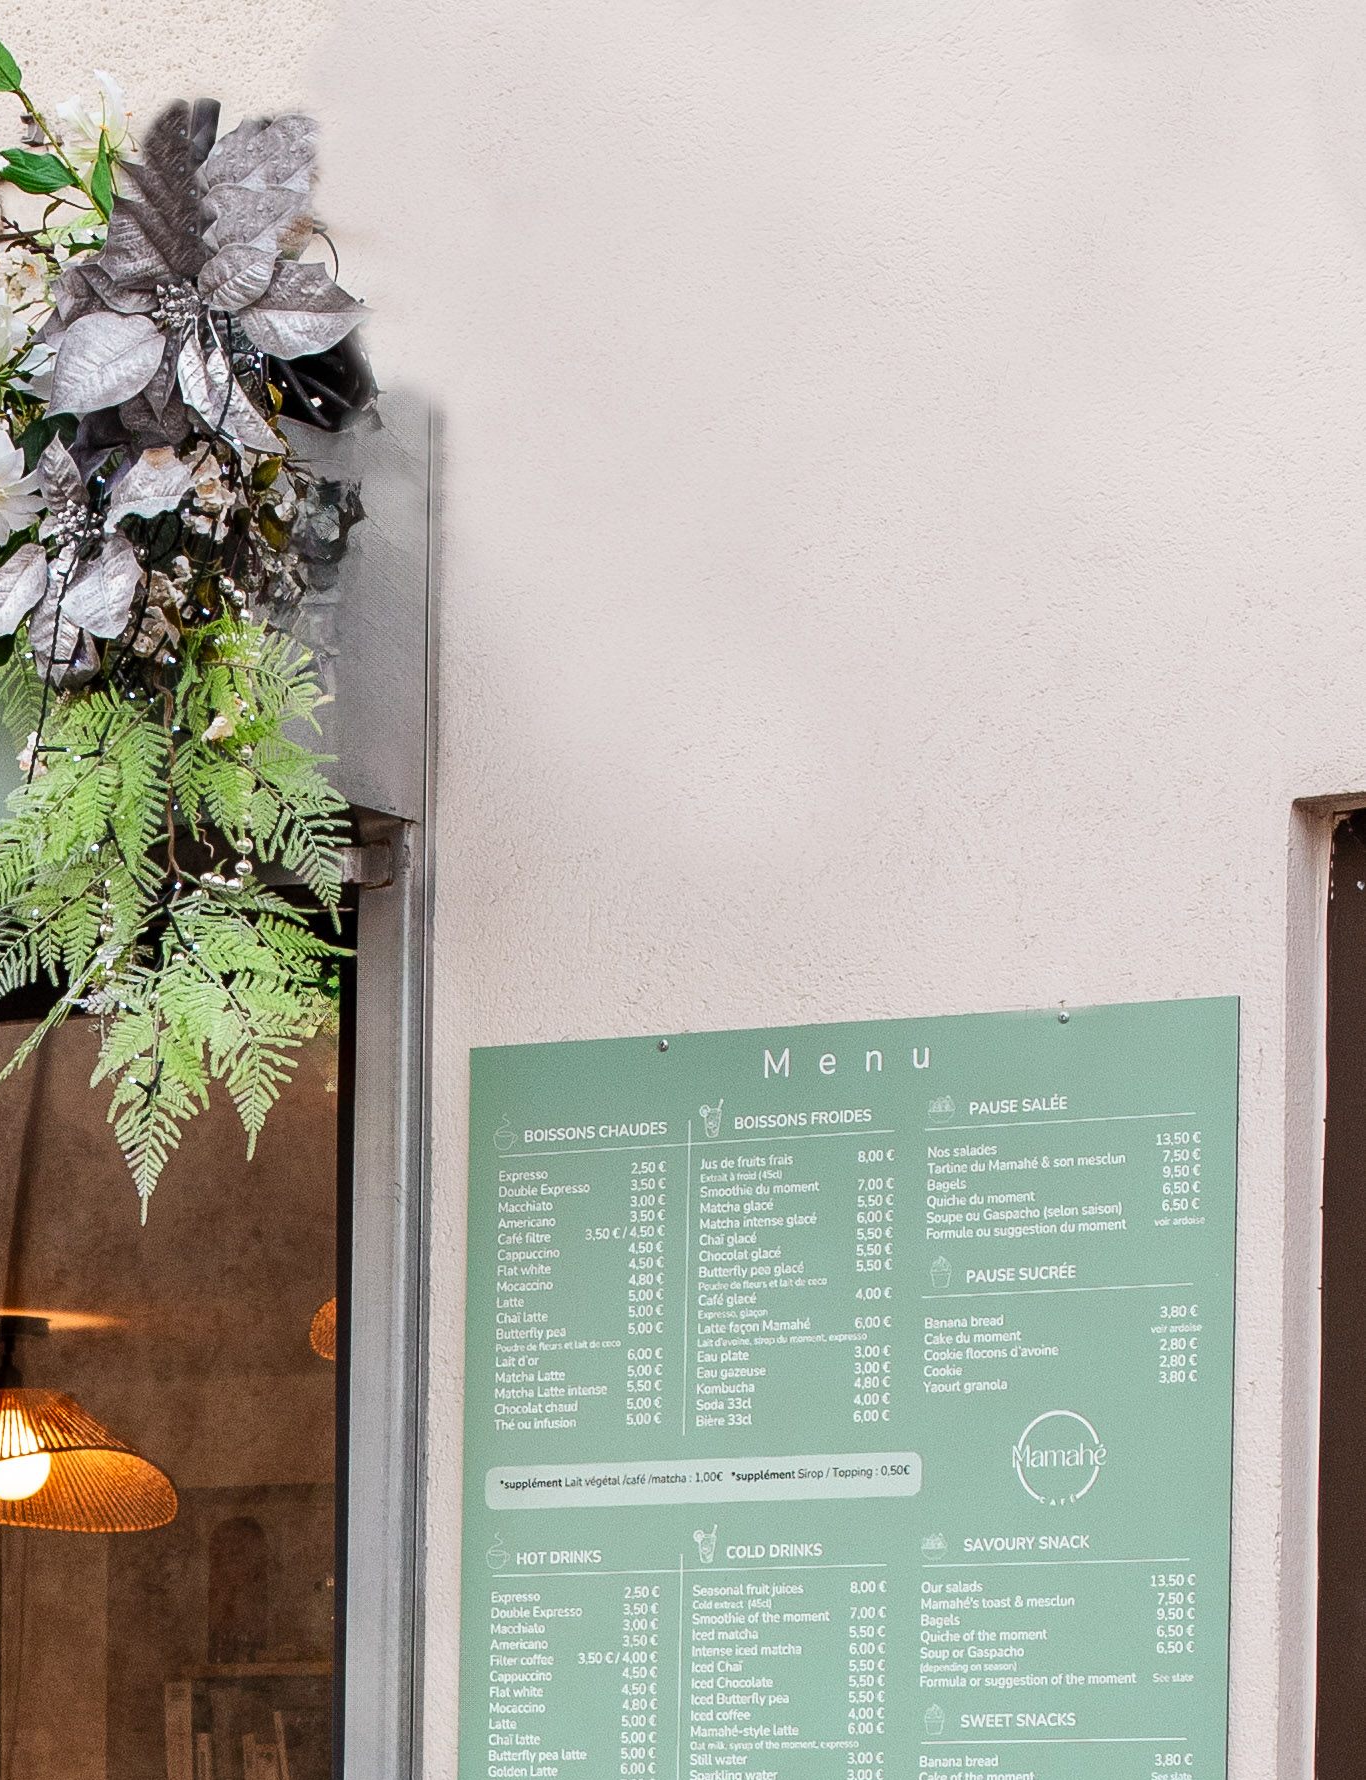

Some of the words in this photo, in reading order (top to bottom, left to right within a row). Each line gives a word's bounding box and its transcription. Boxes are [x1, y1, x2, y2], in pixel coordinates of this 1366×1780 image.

[762, 1043, 933, 1080] Menu
[969, 1099, 1018, 1115] PAUSE
[1021, 1094, 1068, 1112] SALÉE
[734, 1113, 807, 1130] BOISSONS
[811, 1109, 872, 1124] FROIDES
[524, 1126, 596, 1143] BOISSONS
[599, 1121, 668, 1138] CHAUDES
[927, 1145, 951, 1158] Nos
[953, 1143, 998, 1158] salades
[927, 1161, 968, 1174] Tartine
[970, 1160, 986, 1173] du
[987, 1157, 1039, 1173] Mamahé
[1041, 1156, 1050, 1168] &
[1053, 1157, 1075, 1168] son
[1077, 1153, 1126, 1167] mesclun
[498, 1170, 549, 1183] Expresso
[498, 1185, 538, 1198] Double
[540, 1184, 591, 1198] Expresso
[927, 1178, 968, 1193] Bagels
[498, 1201, 553, 1214] Macchiato
[700, 1201, 741, 1214] Matcha
[743, 1198, 774, 1214] glacé
[926, 1195, 967, 1209] Quiche
[969, 1193, 984, 1206] du
[987, 1191, 1036, 1205] moment
[498, 1217, 556, 1229] Americano
[497, 1249, 561, 1262] Cappuccino
[699, 1250, 749, 1262] Chocolat
[751, 1246, 782, 1262] glacé
[966, 1267, 1016, 1284] PAUSE
[1018, 1262, 1077, 1282] SUCRÉE
[924, 1316, 968, 1330] Banana
[970, 1314, 1005, 1328] bread
[923, 1364, 963, 1378] Cookie
[1012, 1442, 1108, 1468] Mamahé
[726, 1545, 766, 1559] COLD
[769, 1543, 823, 1558] DRINKS
[963, 1536, 1036, 1552] SAVOURY
[1038, 1535, 1091, 1550] SNACK
[517, 1552, 547, 1565] HOT
[550, 1550, 602, 1564] DRINKS
[960, 1713, 1013, 1728] SWEET
[1016, 1712, 1077, 1727] SNACKS
